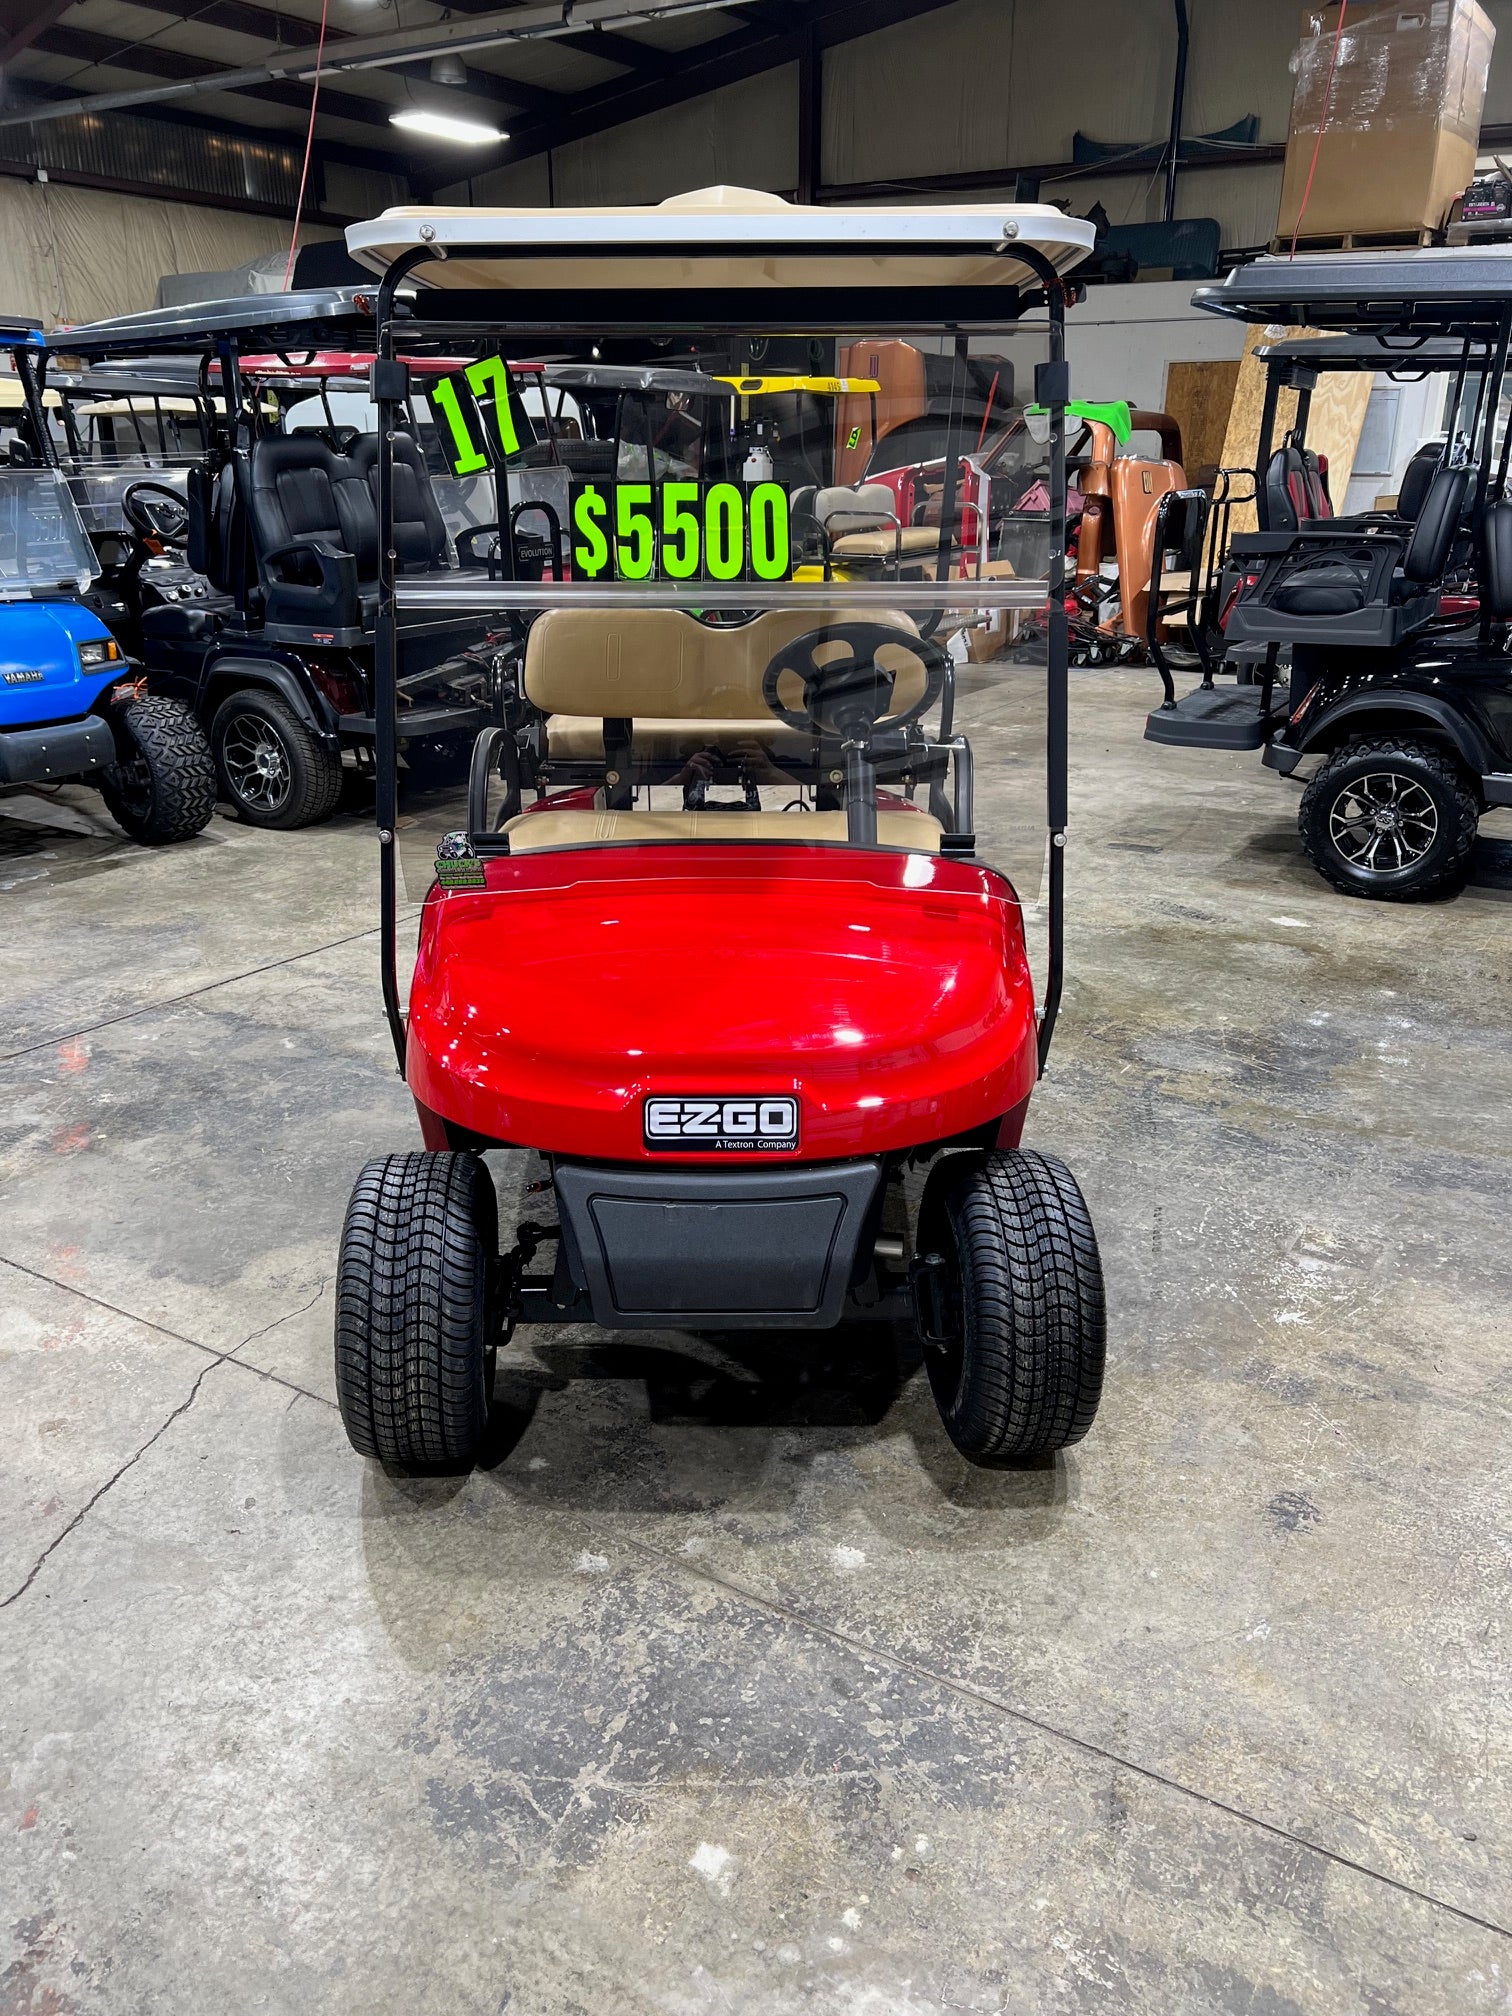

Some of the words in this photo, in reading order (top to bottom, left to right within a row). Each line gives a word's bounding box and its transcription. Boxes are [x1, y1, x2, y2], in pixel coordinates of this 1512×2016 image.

[432, 354, 520, 475] 17
[574, 482, 789, 580] $5500
[520, 547, 553, 558] EVOLUTION
[3, 671, 44, 684] YAMAHA
[649, 1103, 793, 1134] EZGO
[715, 1141, 722, 1149] A
[723, 1140, 754, 1149] Textron
[757, 1140, 797, 1150] Company
